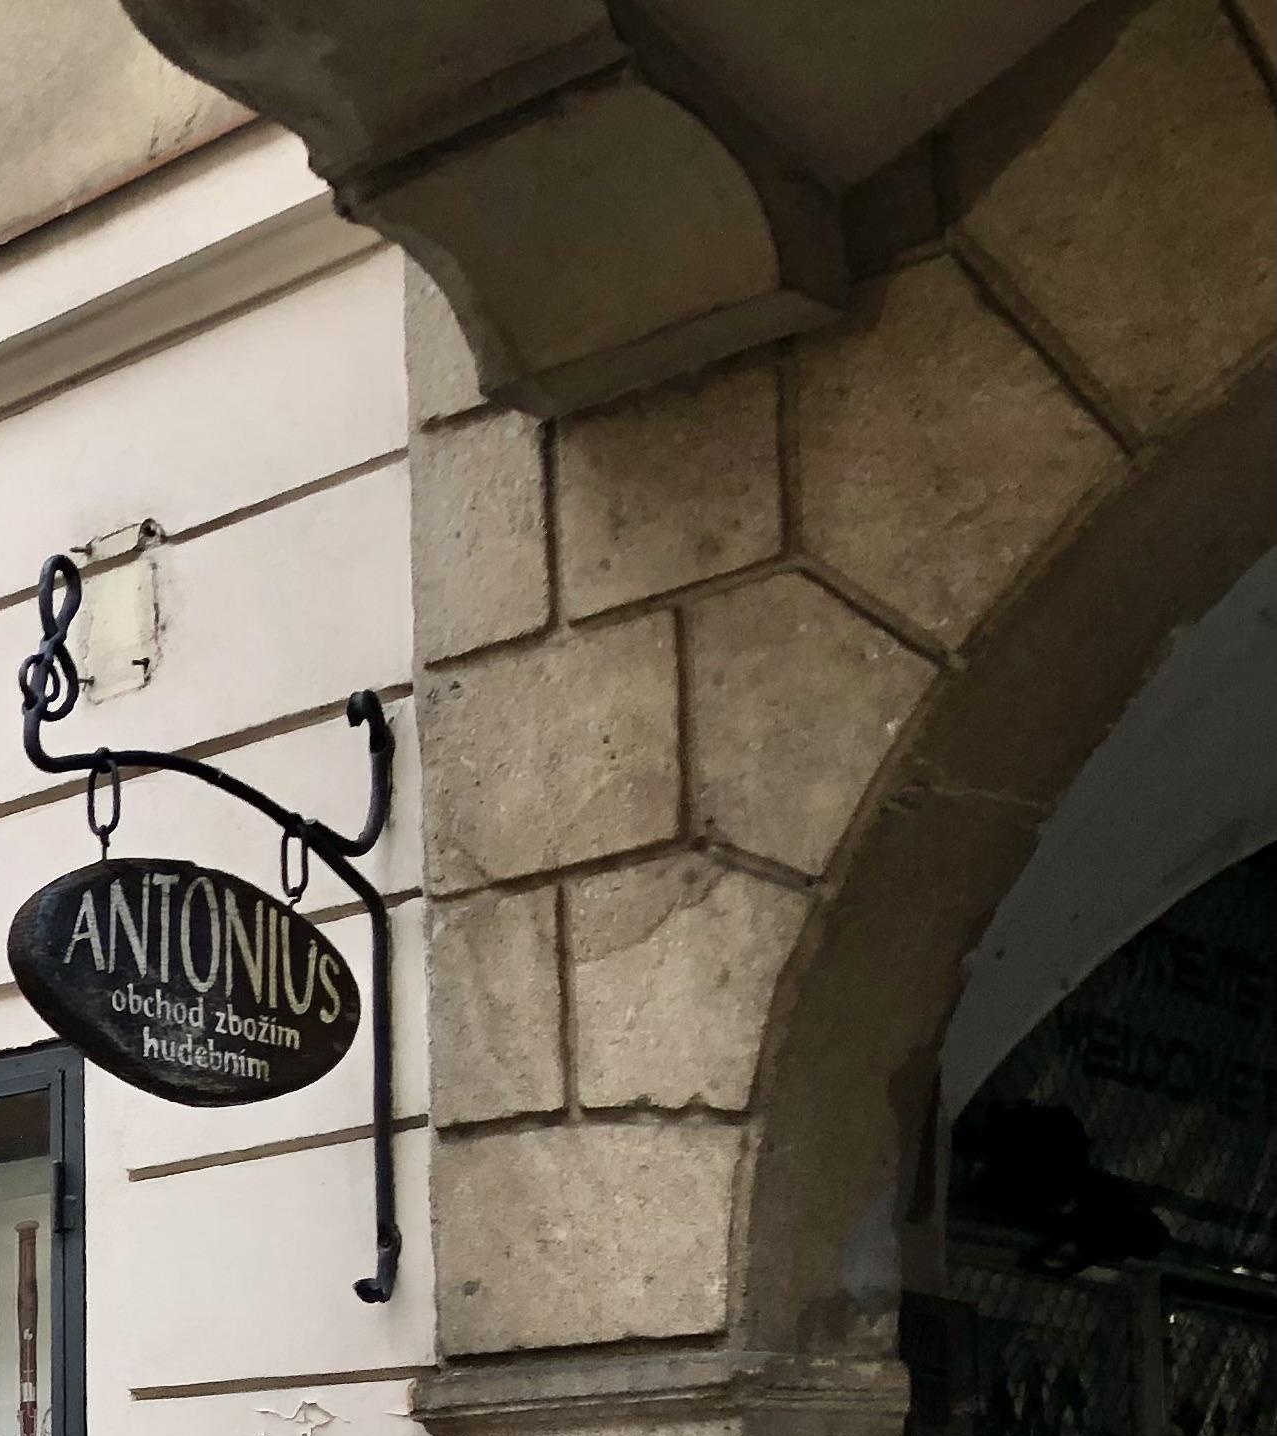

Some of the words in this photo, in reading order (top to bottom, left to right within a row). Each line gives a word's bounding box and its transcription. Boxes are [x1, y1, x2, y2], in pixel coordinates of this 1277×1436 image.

[62, 872, 342, 1025] ANTONIUS
[111, 982, 205, 1029] obchod
[213, 1003, 301, 1051] zbožím
[142, 1026, 271, 1082] hudebním
